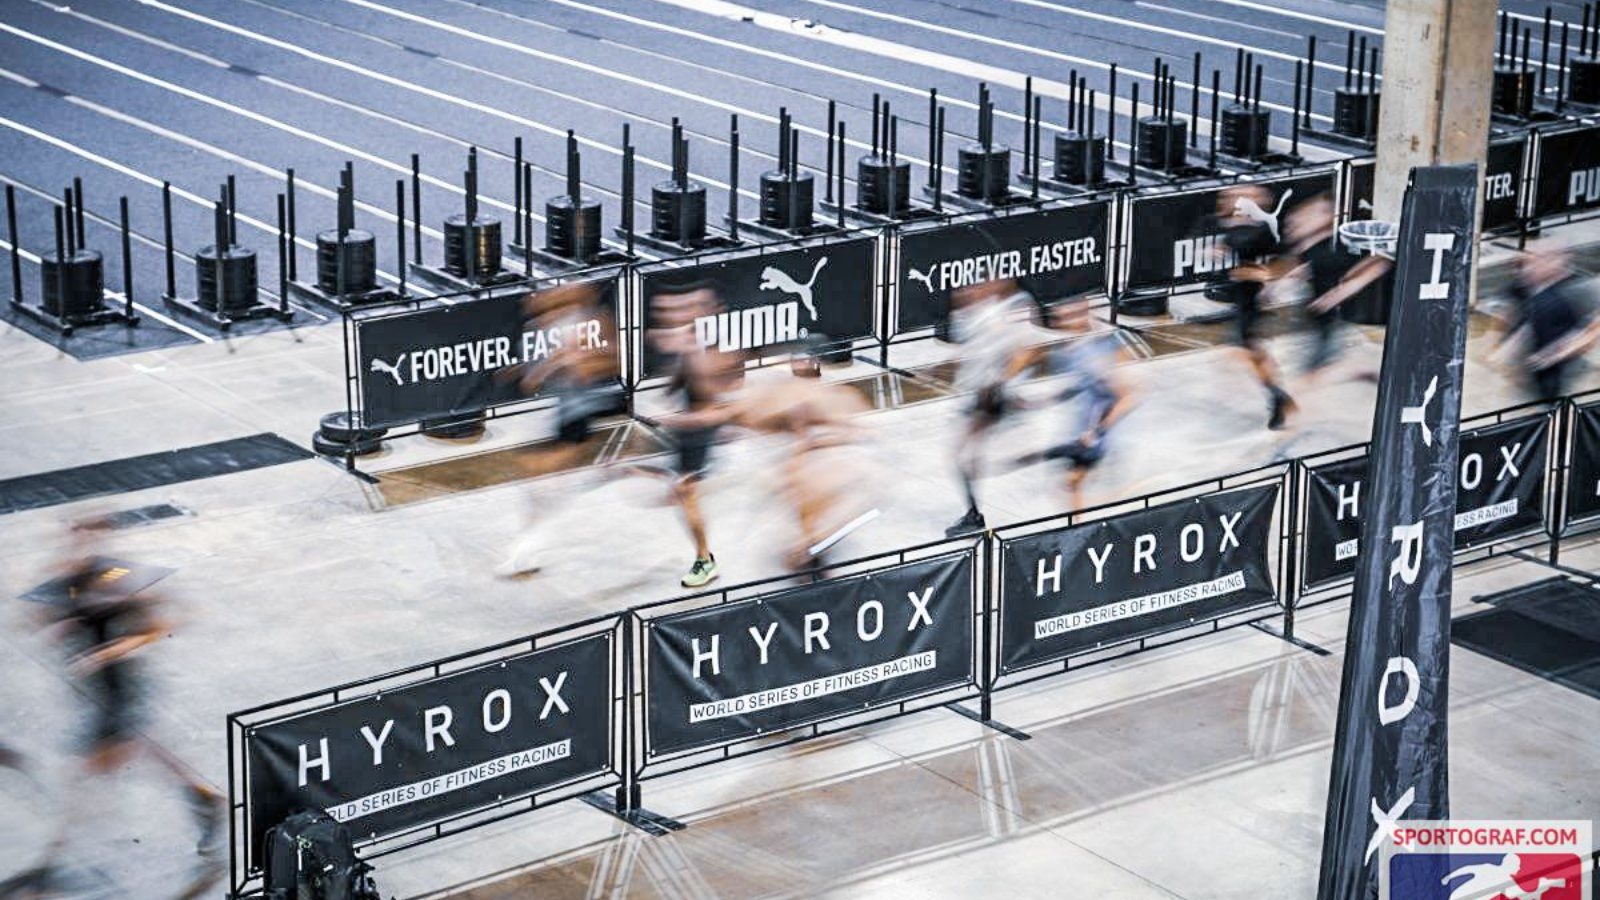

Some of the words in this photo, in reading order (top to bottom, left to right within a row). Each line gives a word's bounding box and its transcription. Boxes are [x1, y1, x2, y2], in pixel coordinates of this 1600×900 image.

[1485, 172, 1515, 200] TER.
[1568, 166, 1600, 205] PU
[939, 252, 1026, 290] FOREVER.
[1030, 237, 1100, 273] FASTER.
[695, 302, 798, 352] PUMA
[410, 336, 518, 382] FOREVER.
[1478, 503, 1515, 520] RACING
[1036, 512, 1243, 597] HYROX
[1364, 233, 1455, 866] HYROX
[691, 587, 935, 678] HYROX
[1037, 616, 1081, 636] WORLD
[1085, 604, 1126, 624] SERIES
[1131, 601, 1146, 613] OF
[1150, 587, 1197, 609] FITNESS
[1202, 575, 1242, 595] RACING
[693, 700, 745, 719] WORLD
[749, 688, 798, 708] SERIES
[803, 681, 820, 697] OF
[824, 668, 878, 692] FITNESS
[883, 654, 932, 676] RACING
[298, 671, 571, 787] HYROX
[361, 787, 416, 811] SERIES
[421, 779, 440, 796] OF
[446, 759, 506, 788] FITNESS
[511, 743, 567, 769] RACING
